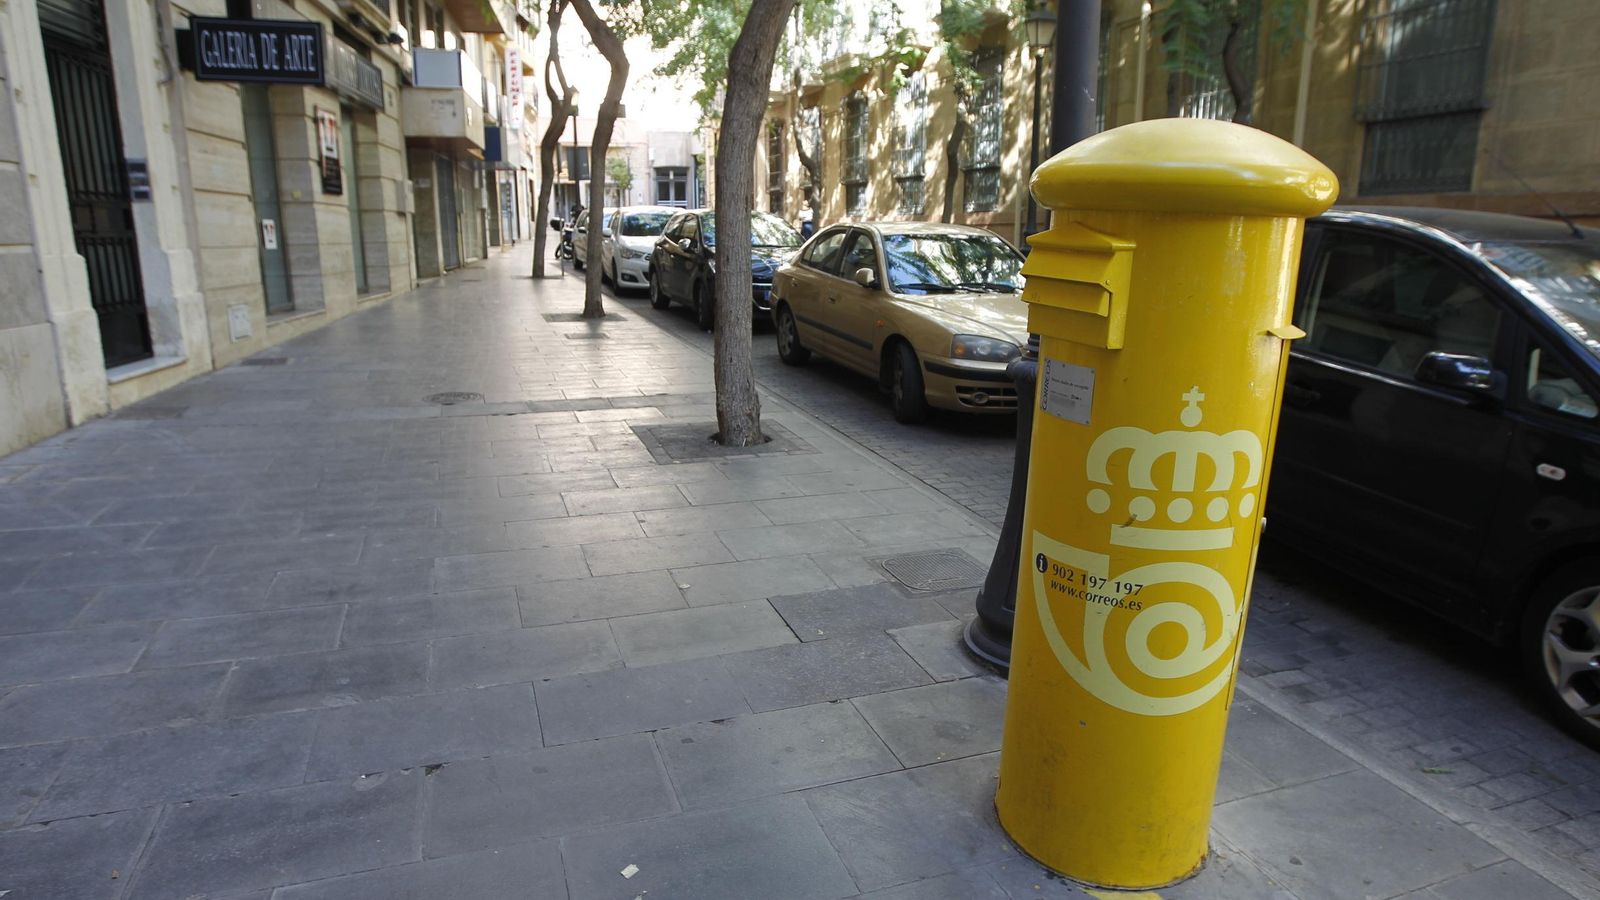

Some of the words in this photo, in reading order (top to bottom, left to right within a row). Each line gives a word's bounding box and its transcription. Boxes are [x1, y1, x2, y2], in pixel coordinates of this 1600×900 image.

[201, 29, 259, 70] GALERIA
[260, 32, 280, 70] DE
[284, 34, 316, 71] ARTE
[510, 50, 520, 121] PERFUMER
[1050, 579, 1143, 611] www.correos.es
[1052, 563, 1074, 582] 902
[1081, 573, 1107, 590] 197
[1114, 581, 1144, 596] 197
